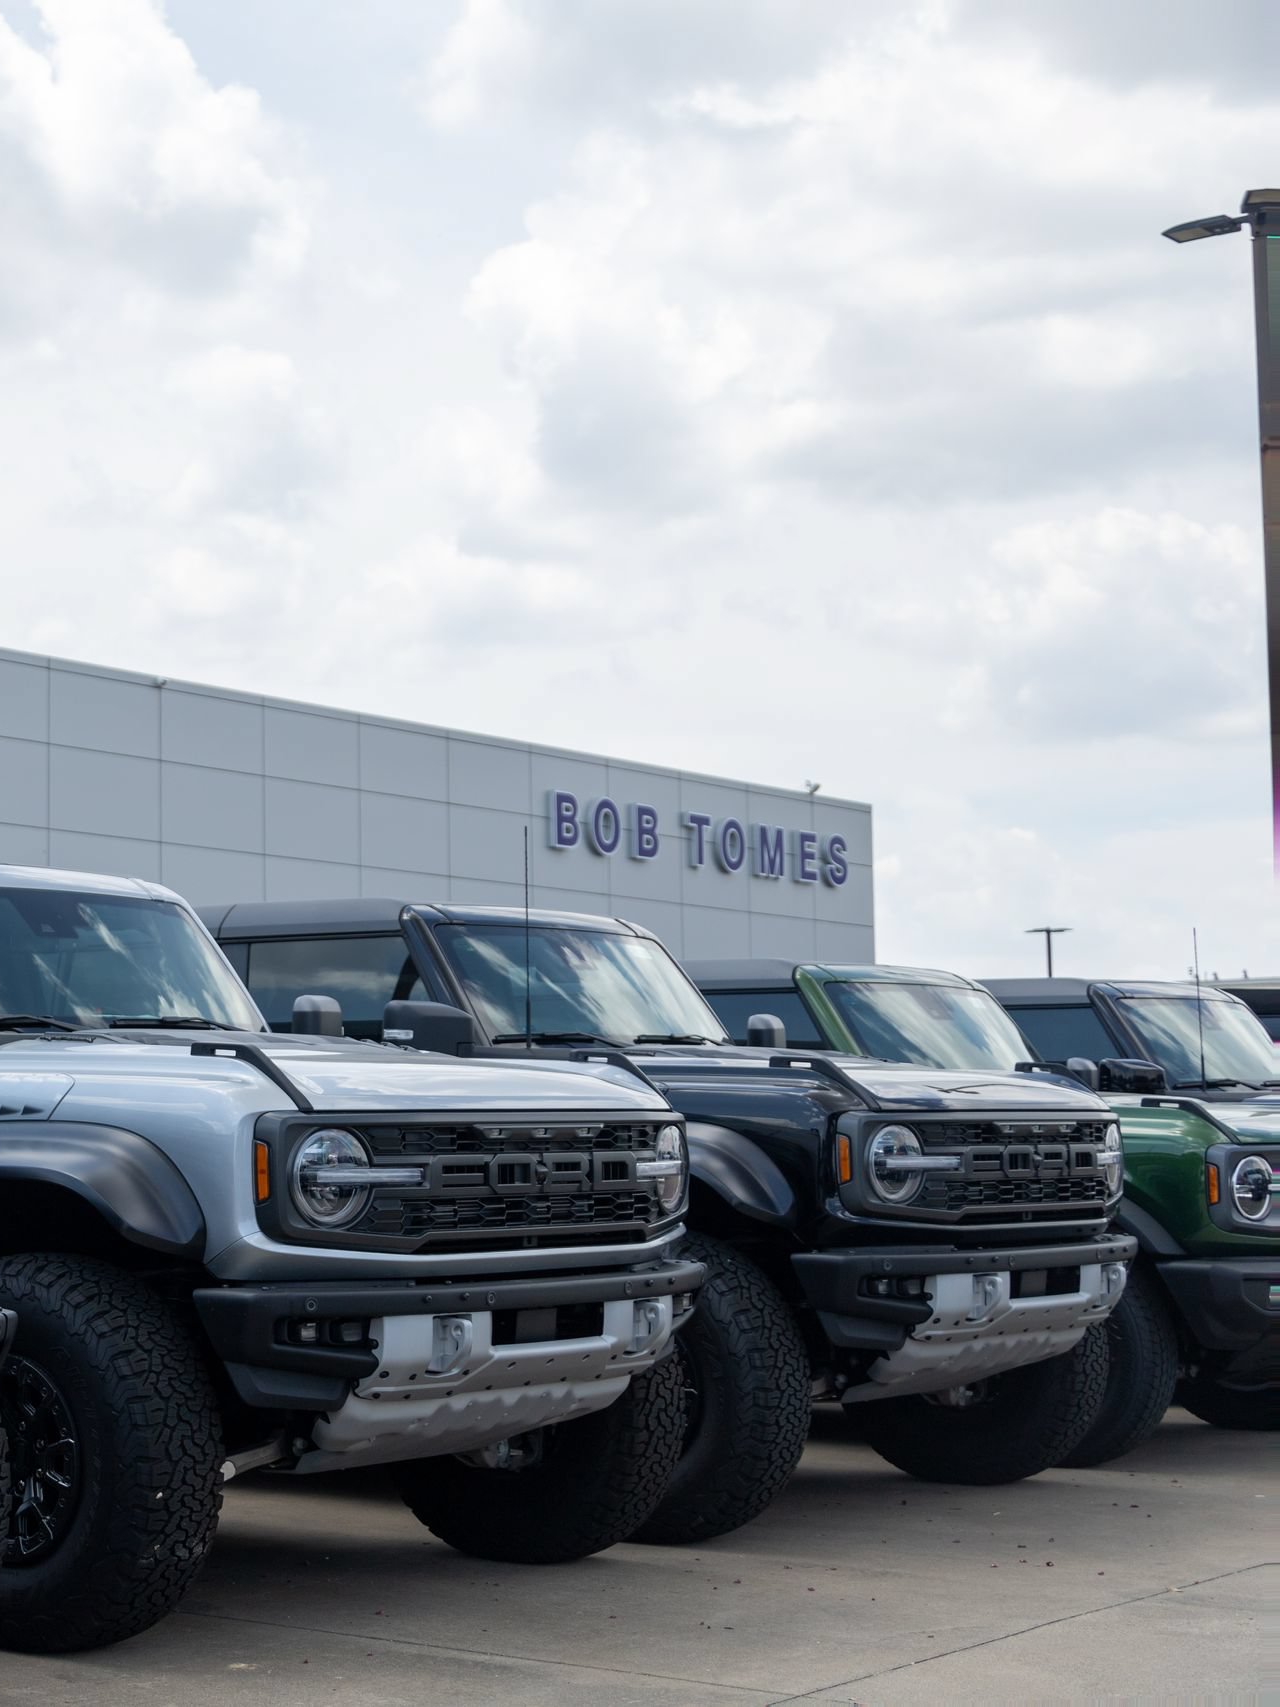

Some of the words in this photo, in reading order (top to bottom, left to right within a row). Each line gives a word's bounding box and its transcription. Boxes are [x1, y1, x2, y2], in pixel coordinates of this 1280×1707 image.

[549, 790, 660, 860] BOB
[682, 811, 849, 888] TOMES
[429, 1151, 638, 1198] FORD
[967, 1143, 1098, 1180] FORD
